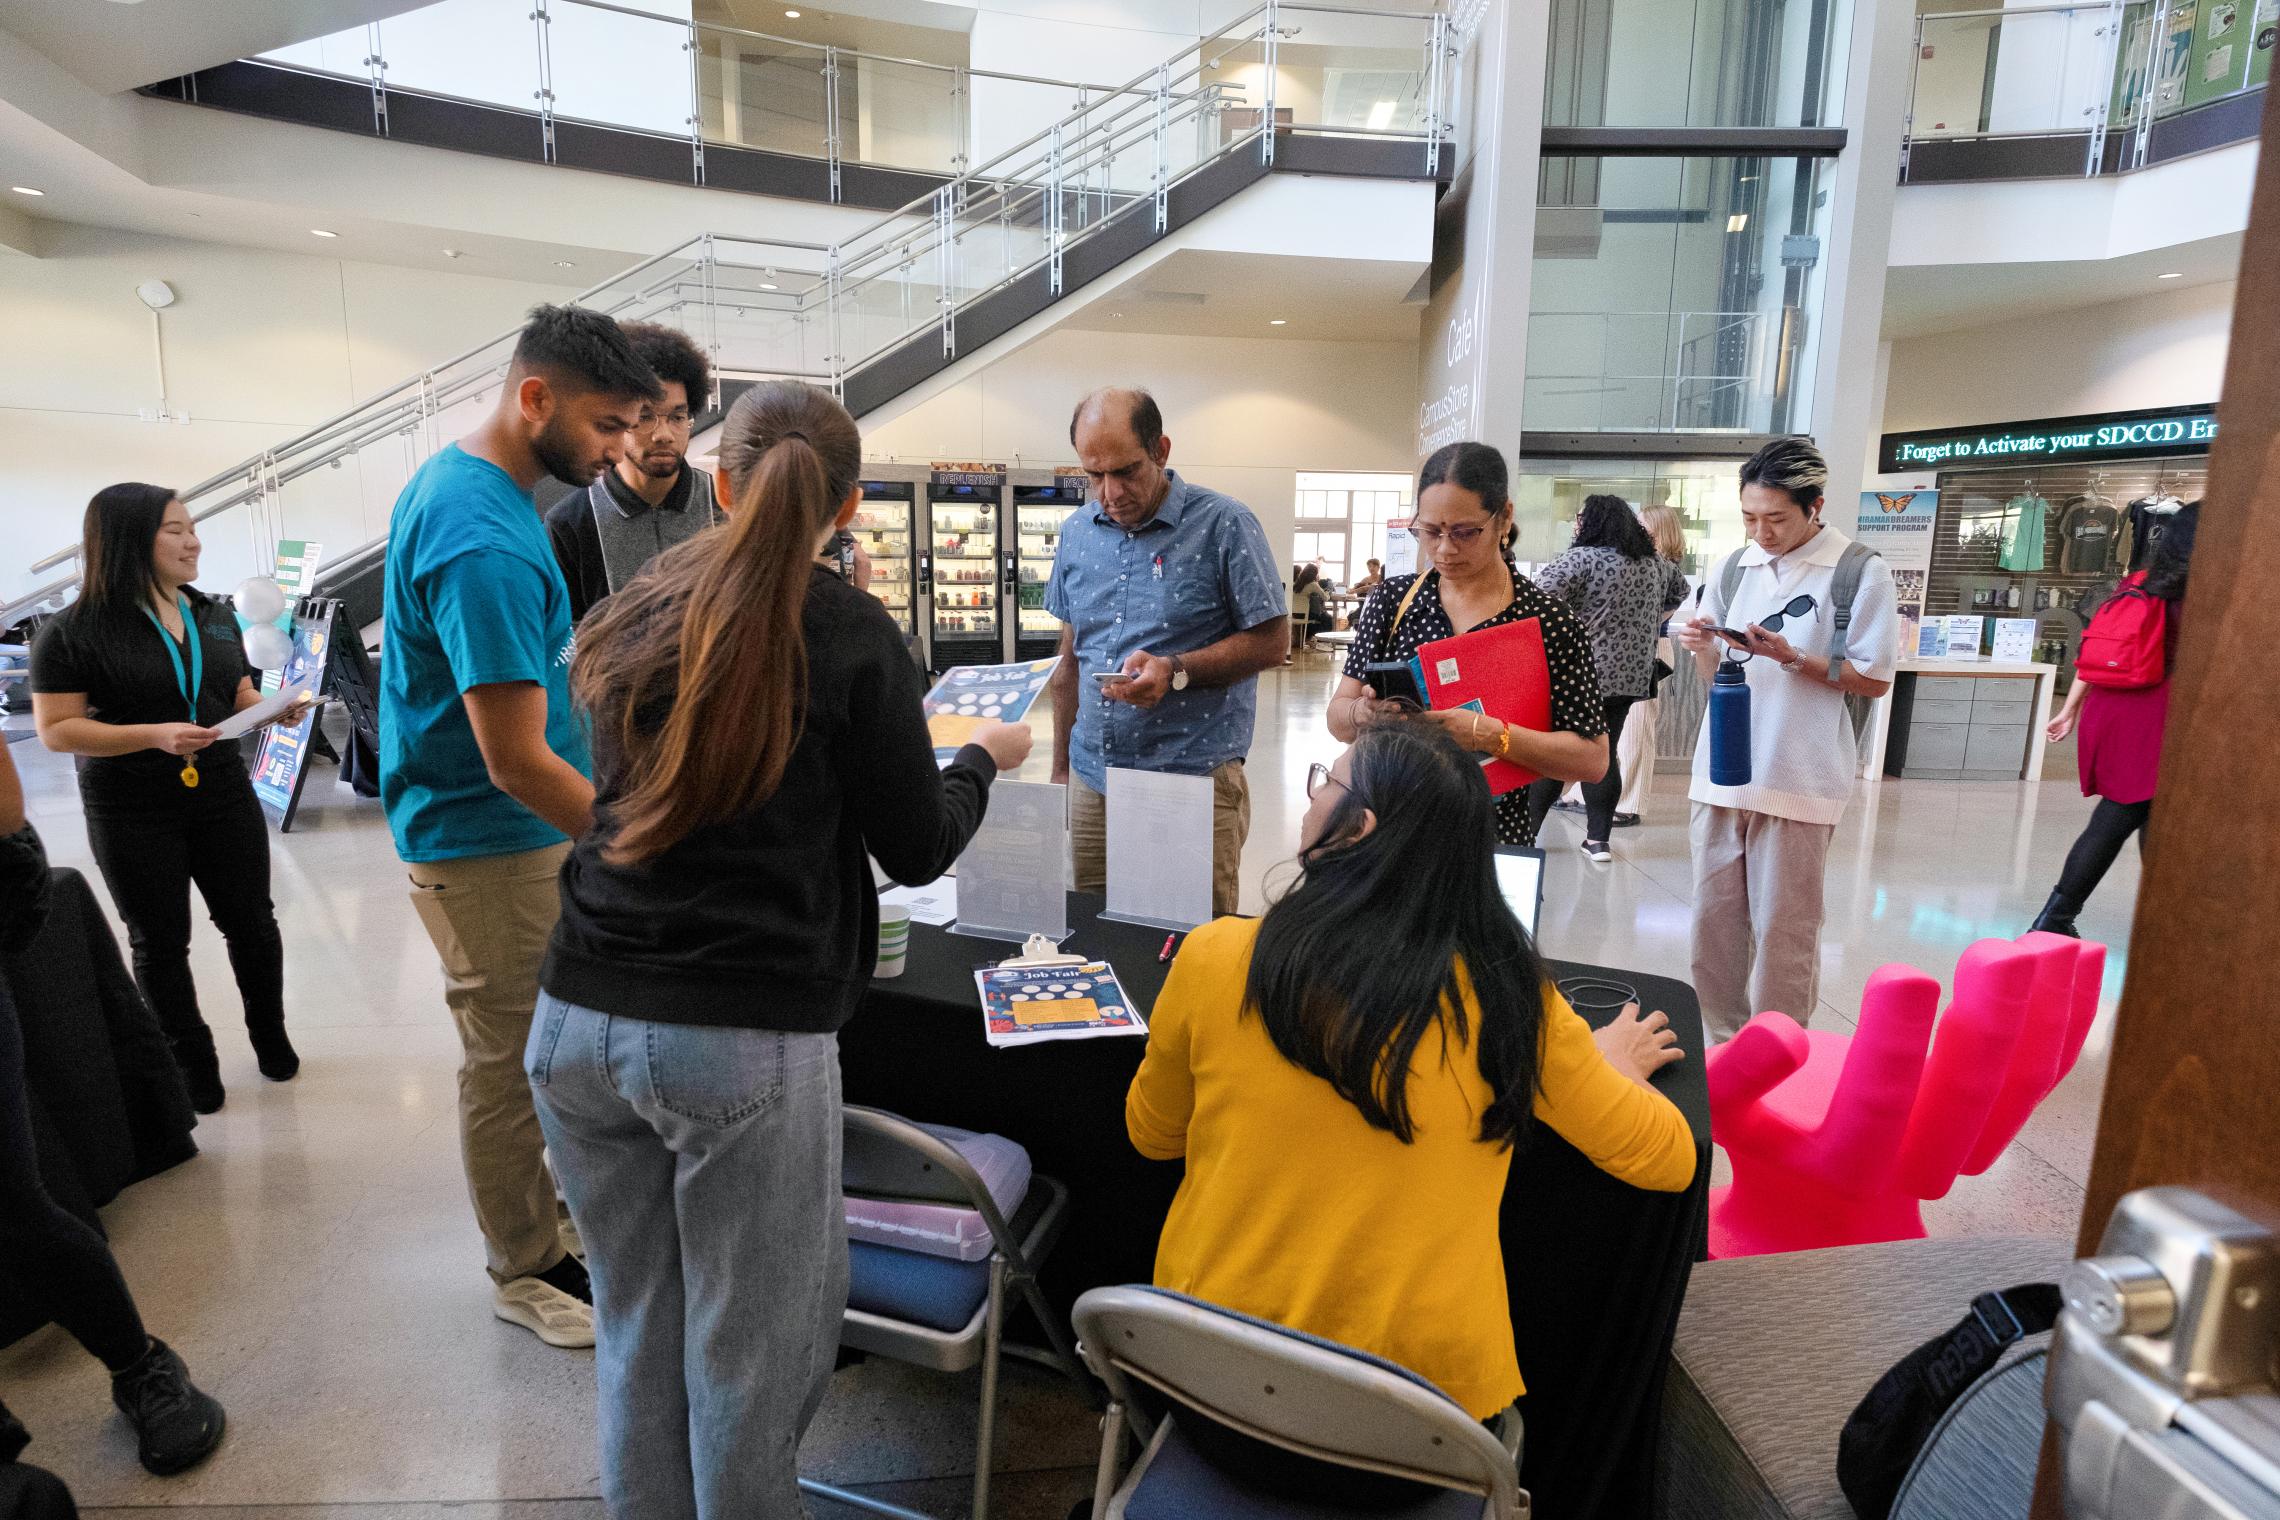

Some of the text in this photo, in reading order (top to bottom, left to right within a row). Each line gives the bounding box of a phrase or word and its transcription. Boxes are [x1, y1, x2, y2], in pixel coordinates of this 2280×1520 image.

[1447, 308, 1472, 368] Cafe
[1902, 442, 1952, 463] Forget
[1955, 441, 1971, 456] to
[1973, 435, 2045, 455] Activate
[2049, 433, 2093, 453] your
[2096, 421, 2184, 446] SDCCD
[939, 473, 999, 486] REPLENISH
[1857, 524, 1928, 532] SUPPORT PROGRAM
[1024, 970, 1081, 980] Job Fair
